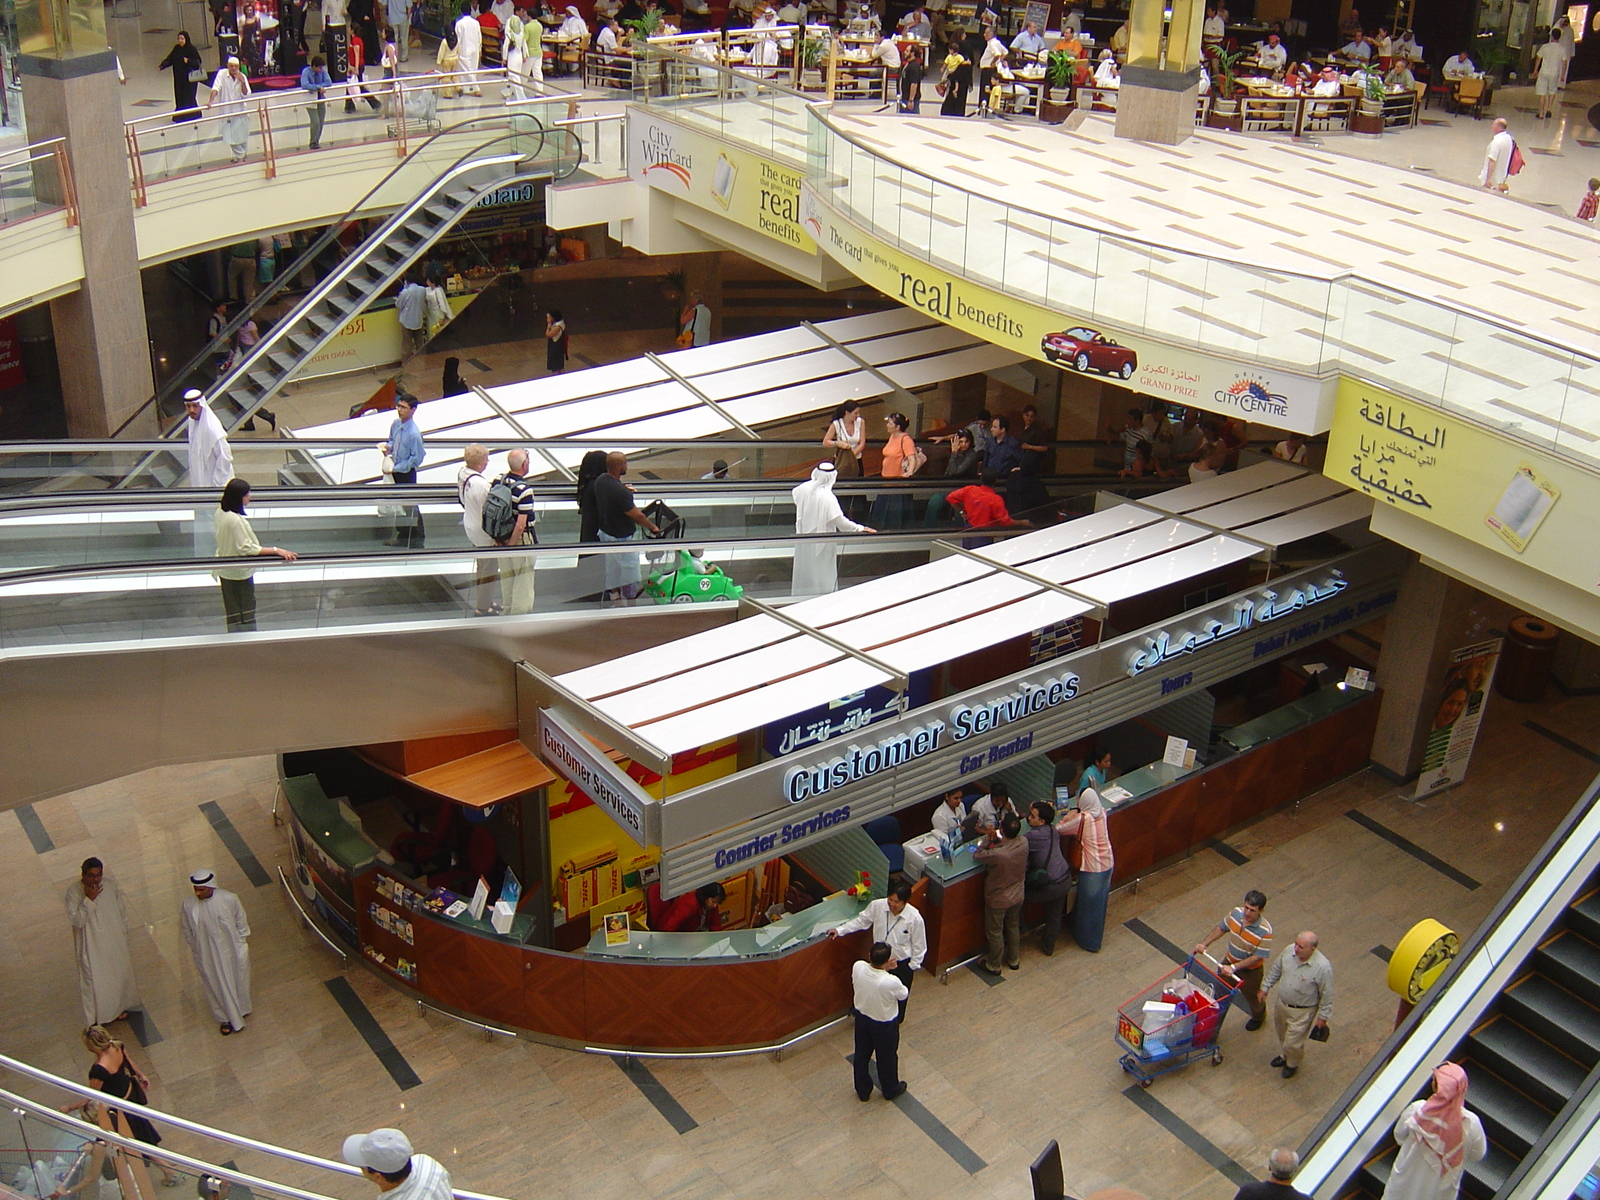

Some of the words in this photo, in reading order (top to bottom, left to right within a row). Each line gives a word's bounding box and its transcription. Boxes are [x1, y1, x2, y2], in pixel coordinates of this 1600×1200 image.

[649, 125, 672, 151] City
[760, 162, 778, 181] The
[780, 173, 802, 190] card
[760, 189, 800, 225] real
[759, 213, 801, 243] benefits
[829, 225, 843, 249] The
[844, 241, 863, 262] card
[888, 262, 899, 272] you
[898, 271, 953, 320] real
[957, 296, 1024, 338] benefits
[1142, 363, 1169, 375] الكبرى
[1170, 369, 1201, 382] الجائزة
[1234, 371, 1270, 386] DEIRA
[1140, 376, 1171, 391] GRAND
[1174, 385, 1198, 398] PRIZE
[1359, 398, 1446, 451] البطاقة
[1360, 434, 1395, 464] مزايا
[1417, 456, 1436, 468] التي
[1350, 454, 1432, 508] حقيقية
[700, 580, 711, 588] 99
[1255, 568, 1348, 622] خدمة
[1127, 599, 1254, 678] العملاء
[1161, 670, 1193, 695] Tours
[785, 719, 945, 804] Customer
[951, 671, 1081, 742] Services
[959, 753, 985, 774] Car
[988, 731, 1034, 764] Rental
[544, 727, 592, 786] Customer
[593, 773, 640, 831] Services
[714, 832, 777, 868] Courier
[781, 805, 851, 844] Services
